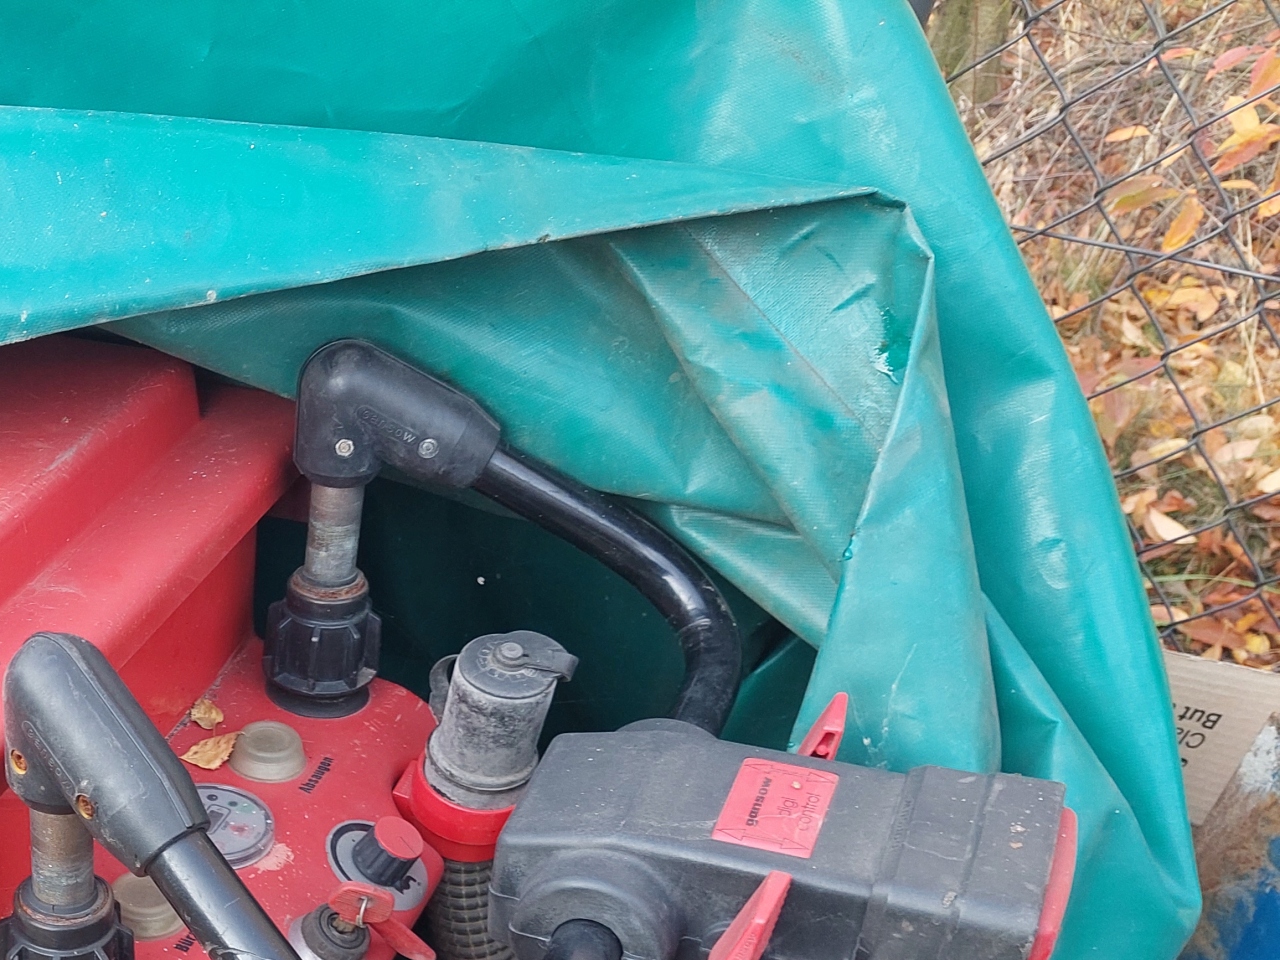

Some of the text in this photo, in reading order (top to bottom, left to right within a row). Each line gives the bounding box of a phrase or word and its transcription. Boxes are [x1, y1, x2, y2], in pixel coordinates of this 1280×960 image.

[1178, 706, 1223, 730] But
[298, 756, 334, 794] Absaugen
[798, 792, 822, 831] control
[173, 931, 196, 952] Bür
